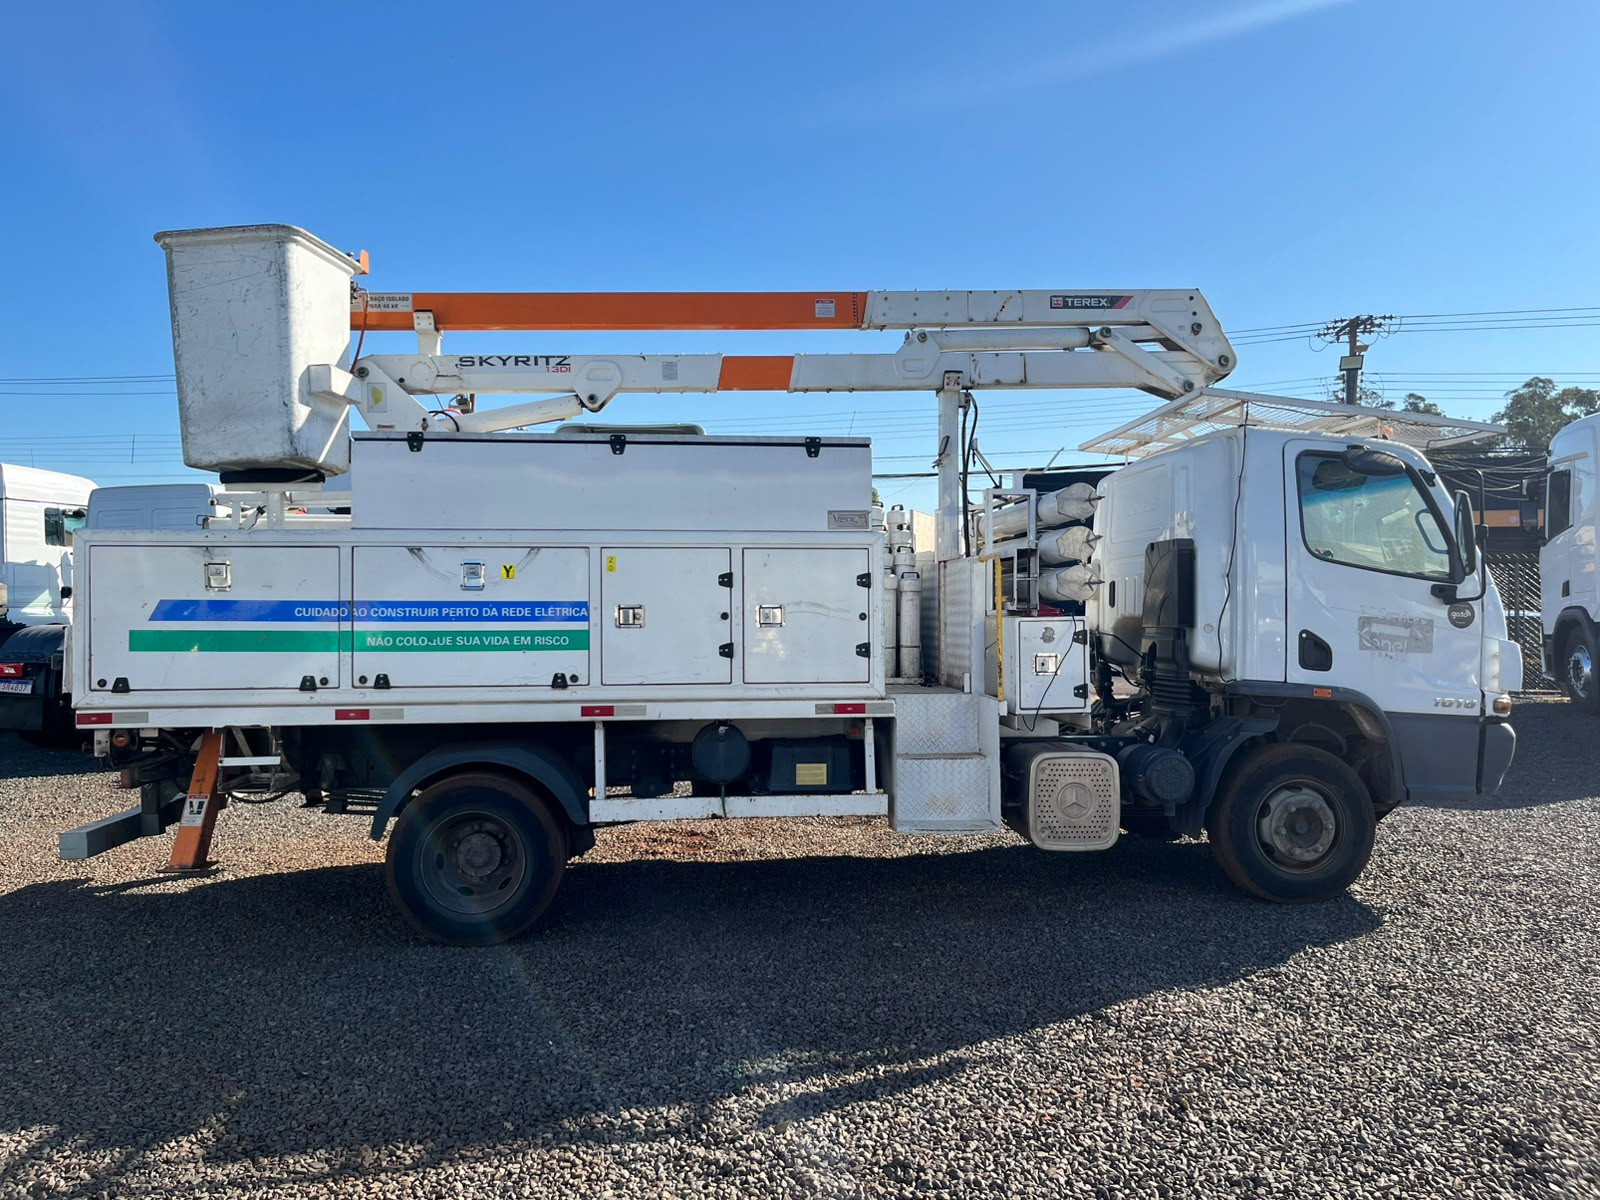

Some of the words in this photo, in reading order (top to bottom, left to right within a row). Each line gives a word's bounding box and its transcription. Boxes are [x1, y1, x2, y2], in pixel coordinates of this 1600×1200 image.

[1065, 298, 1108, 307] TEREX
[459, 356, 571, 367] SKYRITZ
[503, 565, 513, 578] Y
[295, 607, 348, 617] CUIDADO
[352, 607, 367, 617] AO
[370, 607, 439, 617] CONSTRUIR
[442, 607, 479, 617] PERTO
[482, 607, 498, 617] DA
[502, 607, 531, 617] REDE
[535, 605, 588, 617] ELÉTRICA
[366, 634, 393, 646] NÃO
[456, 636, 481, 646] SUA
[483, 636, 510, 646] VIDA
[513, 636, 531, 646] EM
[534, 636, 569, 646] RISCO
